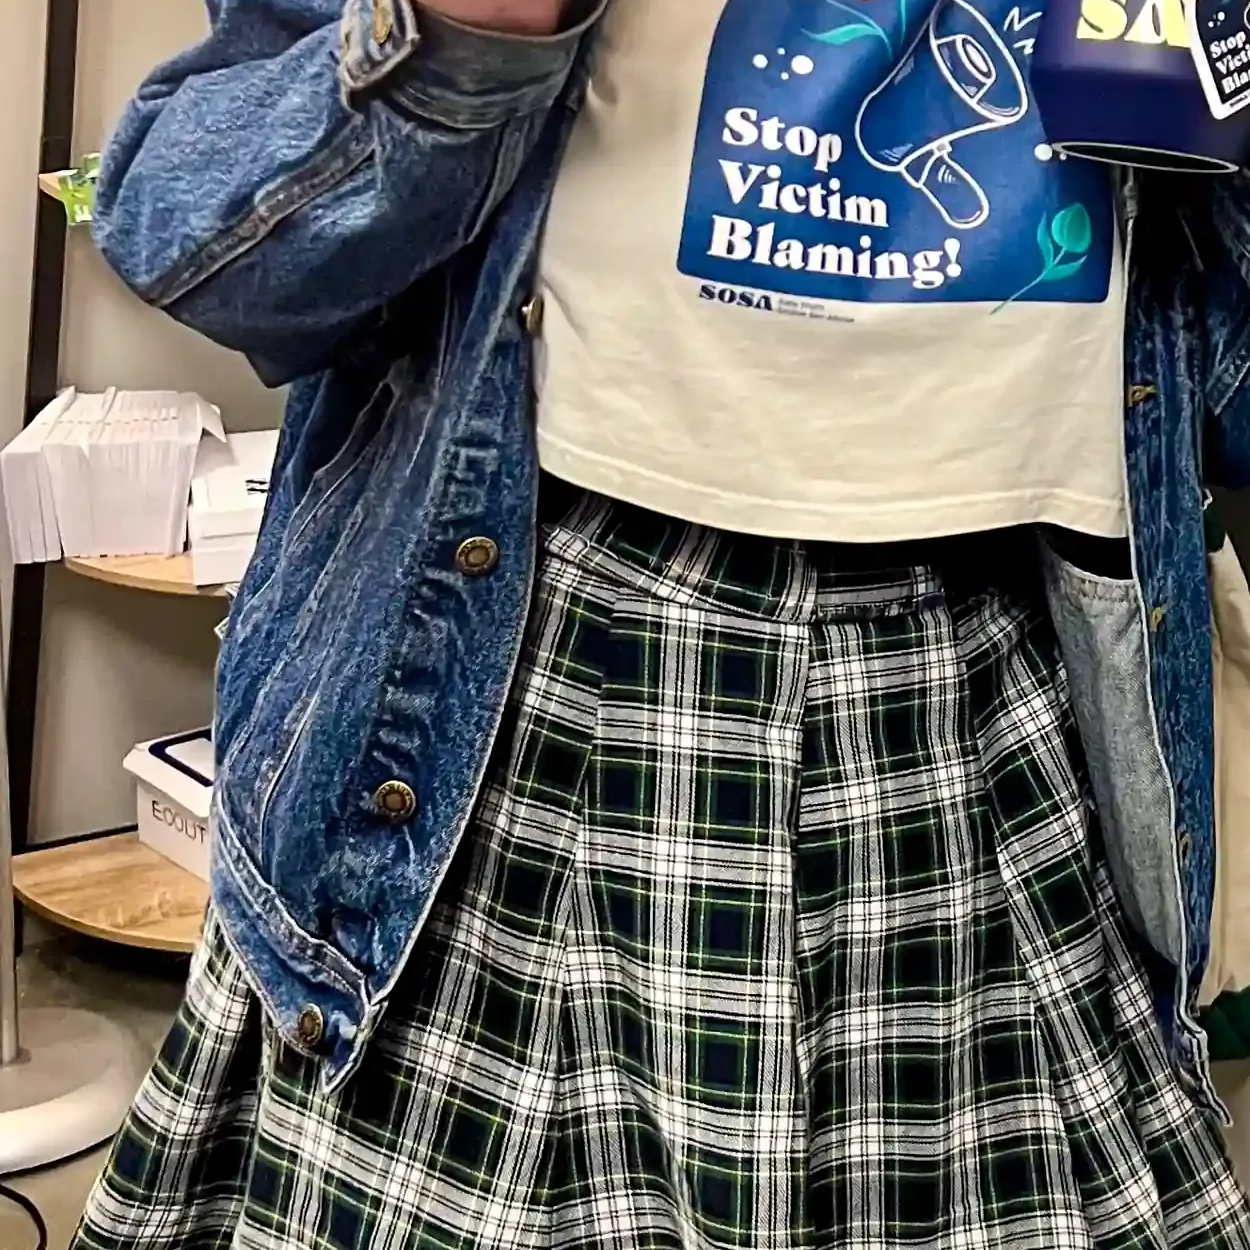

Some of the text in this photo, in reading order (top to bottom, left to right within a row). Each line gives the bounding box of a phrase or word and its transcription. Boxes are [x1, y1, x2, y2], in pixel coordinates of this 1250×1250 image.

[1209, 31, 1247, 59] Stop
[721, 106, 844, 172] Stop
[718, 158, 889, 229] Victim
[706, 214, 963, 290] Blaming!
[699, 283, 774, 312] SOSA
